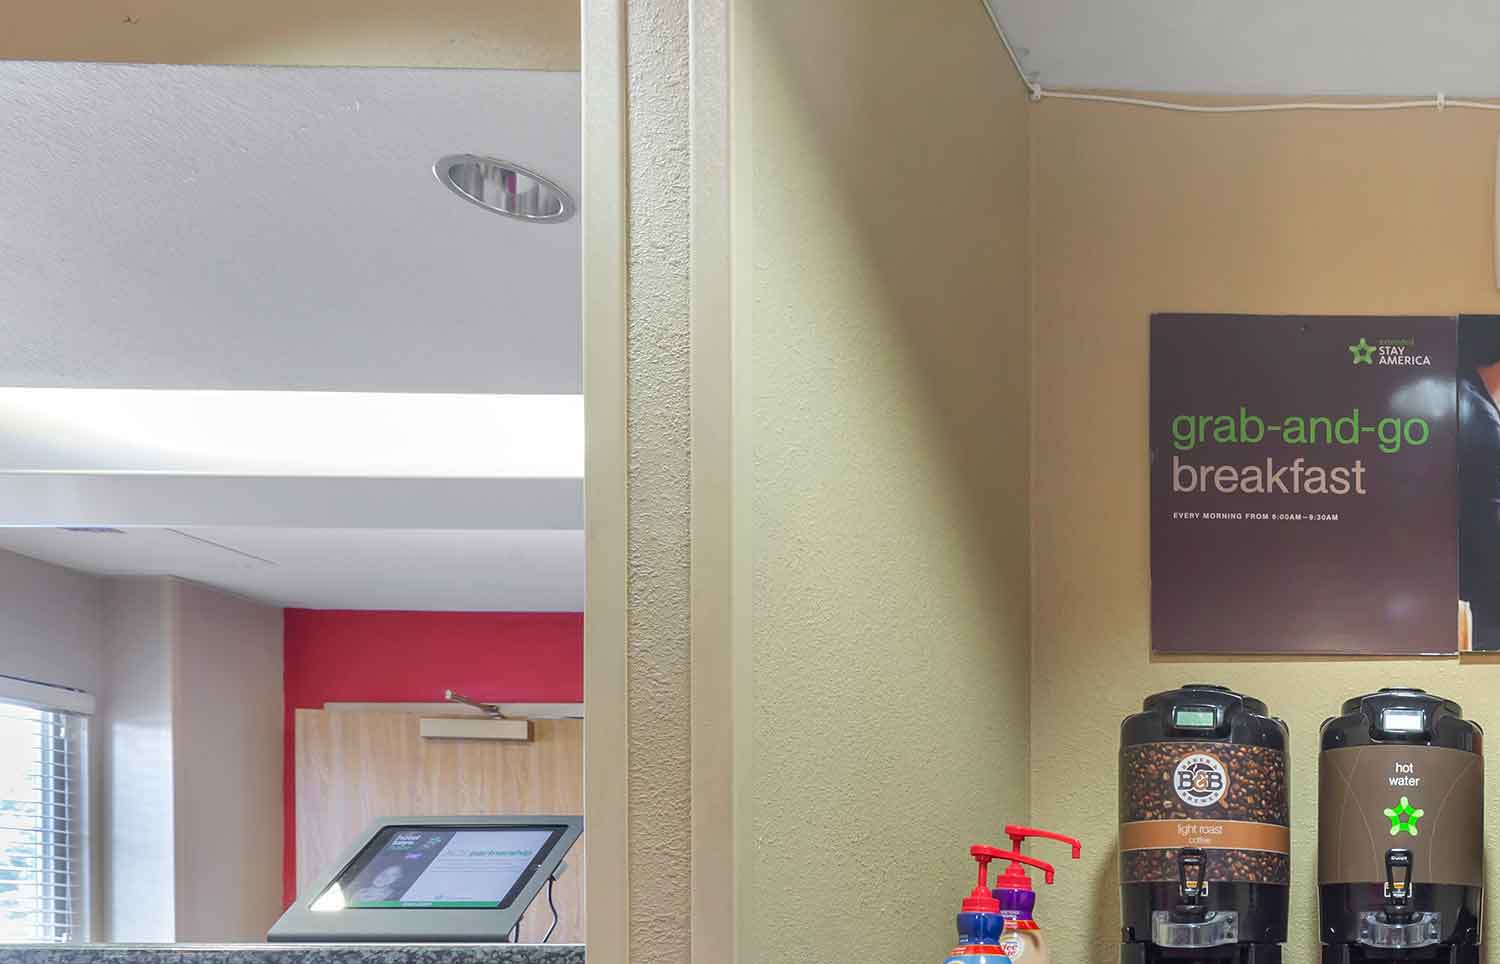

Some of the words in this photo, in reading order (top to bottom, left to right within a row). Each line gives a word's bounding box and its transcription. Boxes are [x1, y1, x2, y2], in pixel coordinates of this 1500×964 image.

[1378, 345, 1406, 356] STAY
[1378, 355, 1431, 366] AMERICA
[1171, 406, 1431, 454] grab-and-go
[1172, 455, 1367, 495] breakfast
[1173, 511, 1200, 520] EVERY
[1202, 512, 1243, 520] MORNING
[1245, 512, 1269, 520] FROM
[1395, 762, 1414, 774] hot
[1388, 776, 1421, 787] water
[1177, 823, 1198, 836] light
